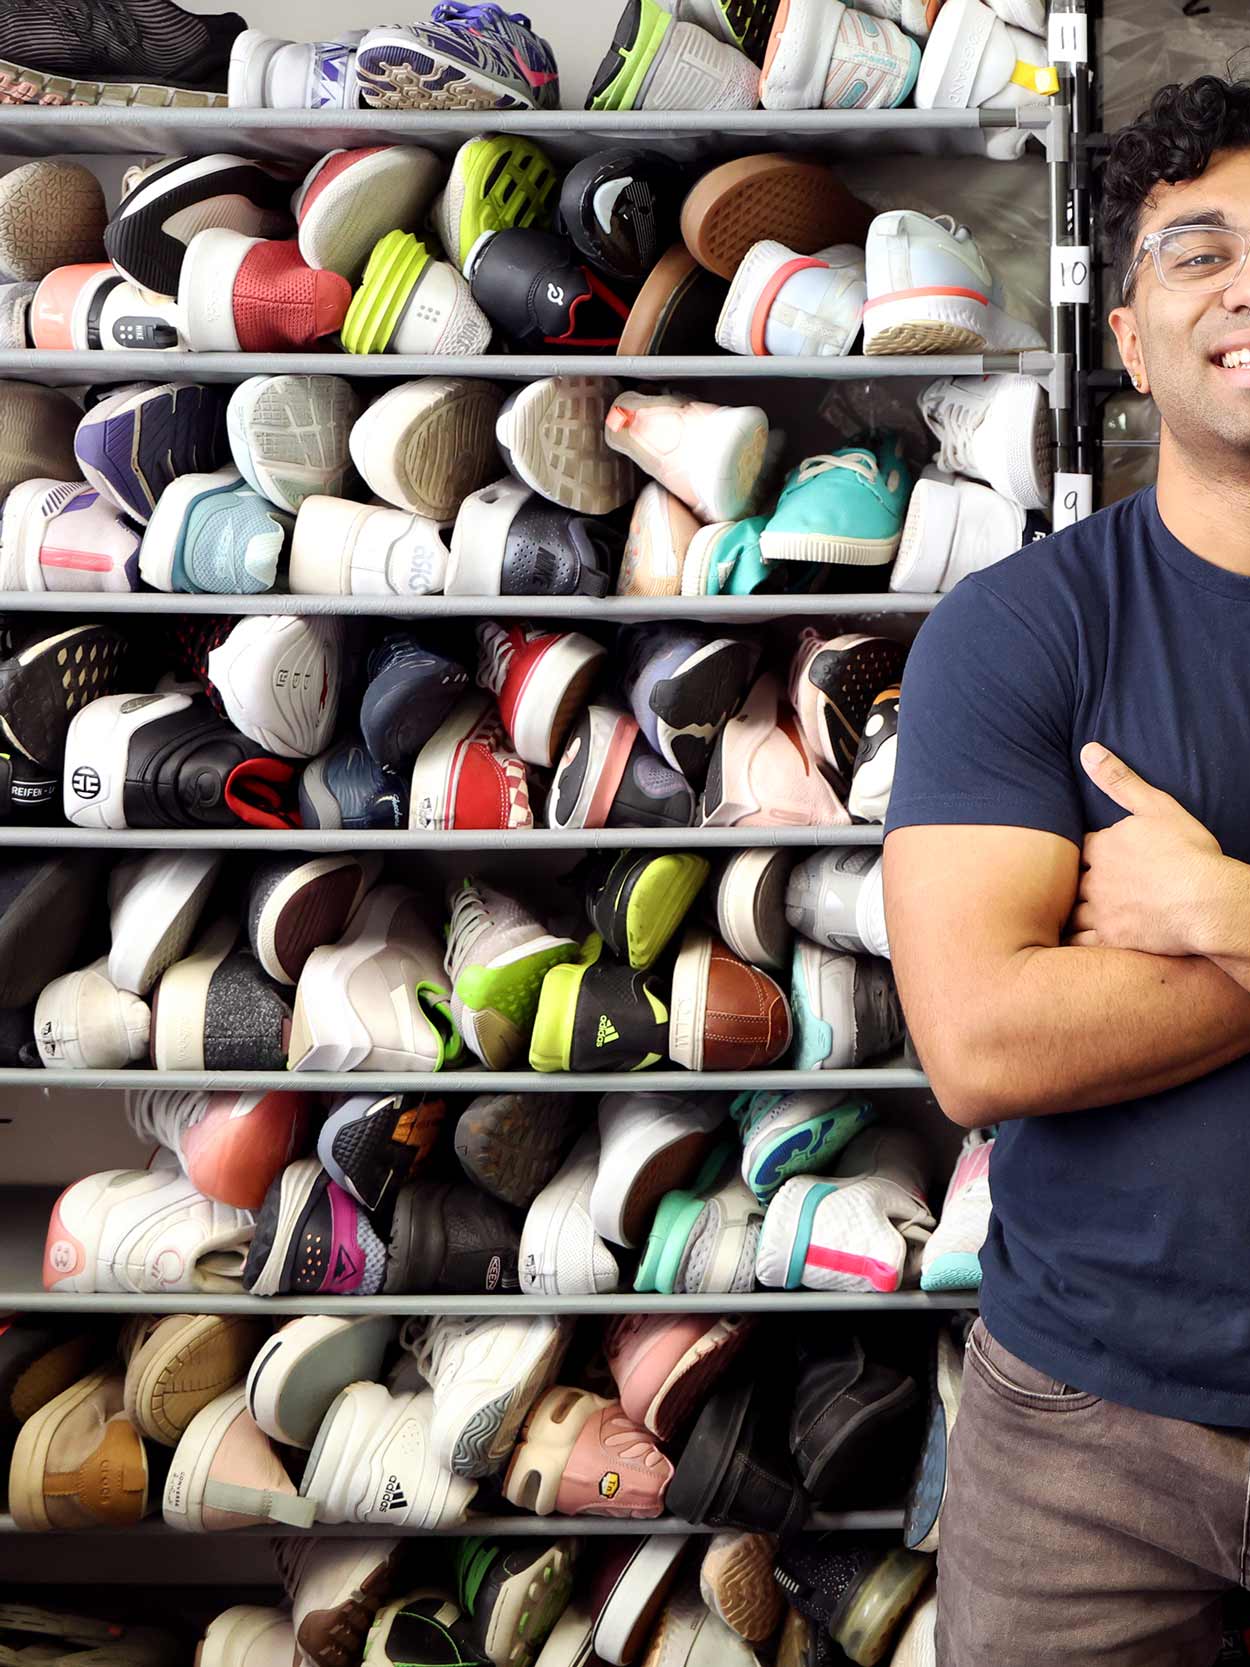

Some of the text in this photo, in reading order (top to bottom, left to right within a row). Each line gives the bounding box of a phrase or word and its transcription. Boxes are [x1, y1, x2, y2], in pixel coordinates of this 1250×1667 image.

[1061, 25, 1077, 51] 11
[1060, 260, 1088, 286] 10
[135, 324, 145, 341] NIKE
[1063, 490, 1079, 522] 9
[531, 545, 558, 591] NIKE
[595, 1014, 607, 1048] adidas
[487, 1257, 500, 1289] KEEN
[379, 1474, 398, 1513] adidas
